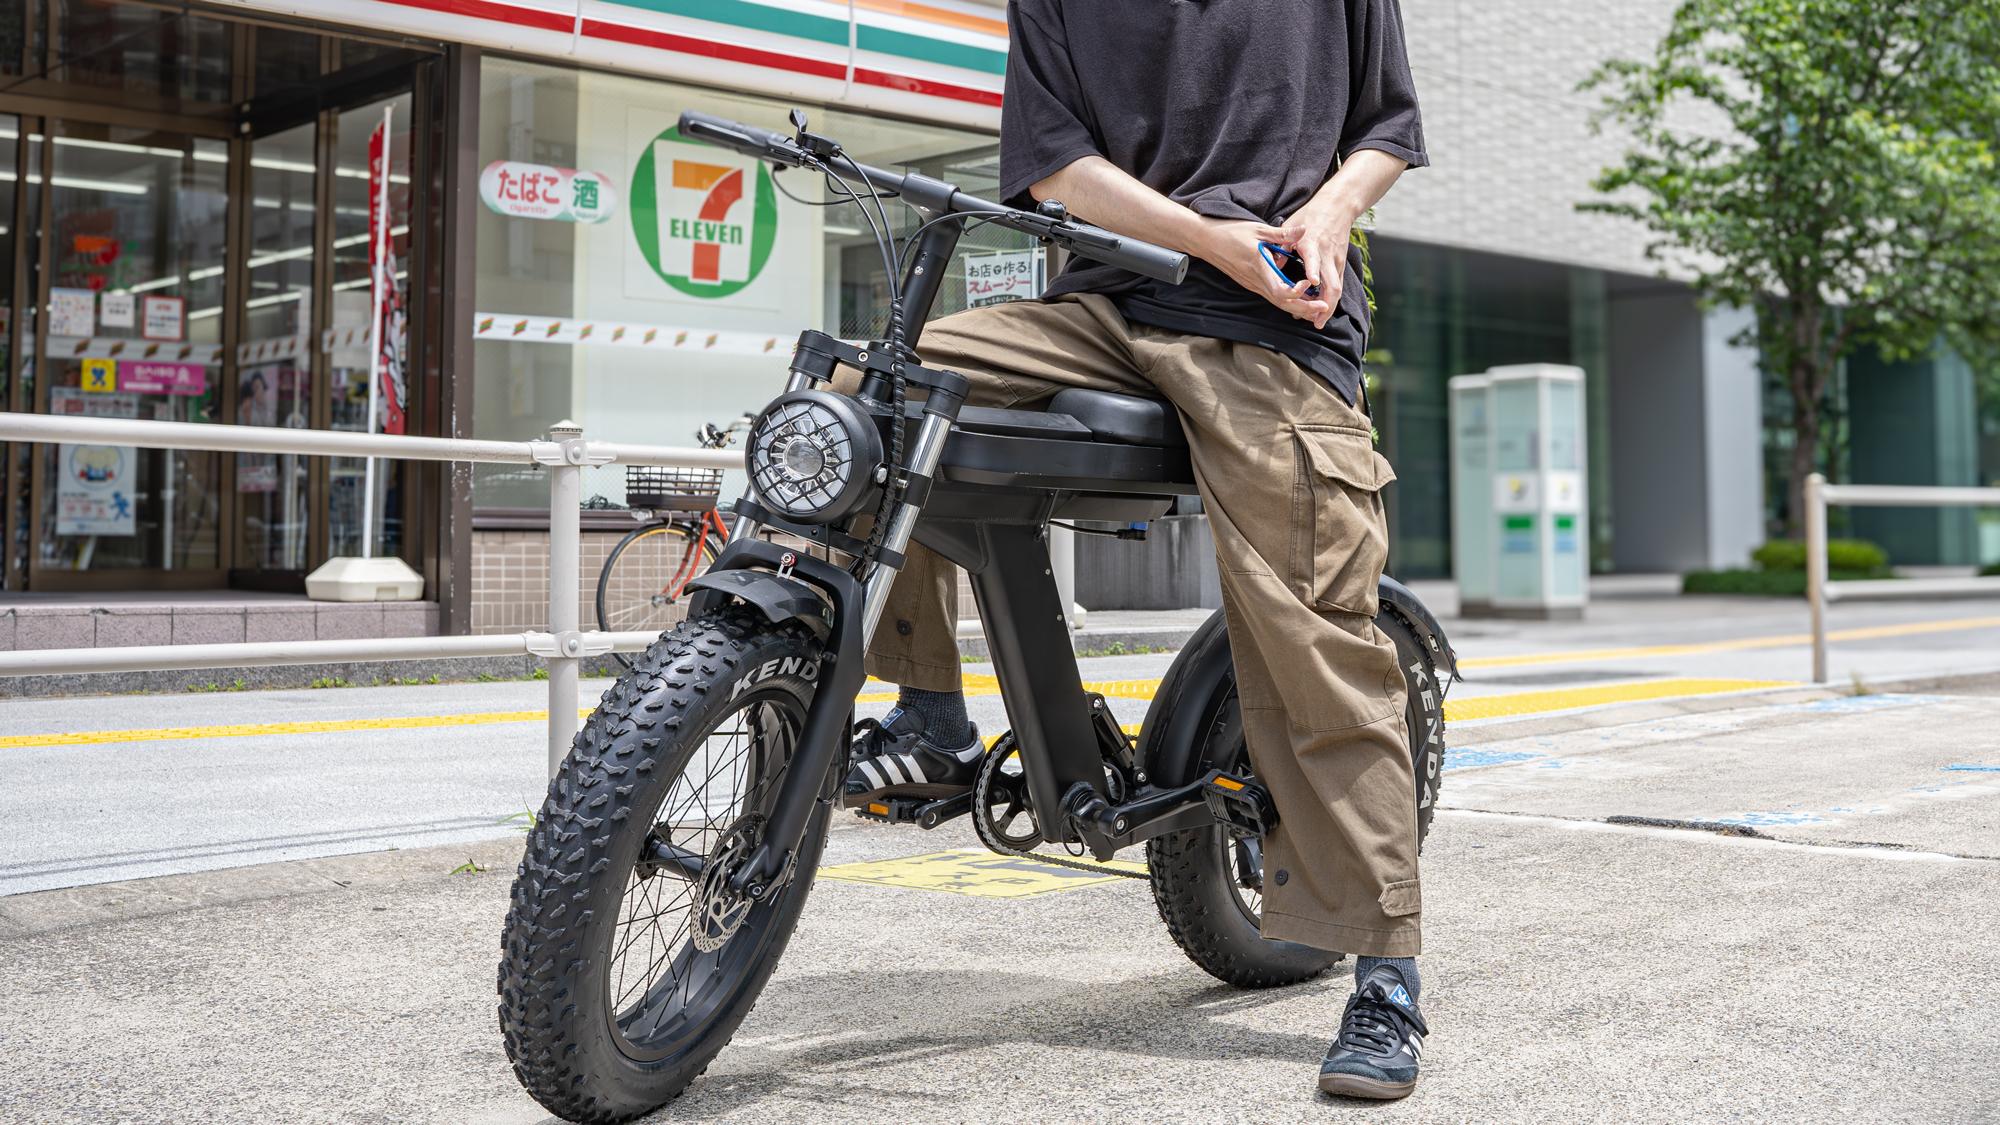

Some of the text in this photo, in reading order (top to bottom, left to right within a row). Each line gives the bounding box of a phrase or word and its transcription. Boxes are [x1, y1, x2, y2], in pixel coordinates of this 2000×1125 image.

[498, 169, 599, 209] たばこ 酒
[968, 275, 1031, 295] スムージー
[729, 656, 820, 702] KEND
[1409, 661, 1439, 809] KENDA
